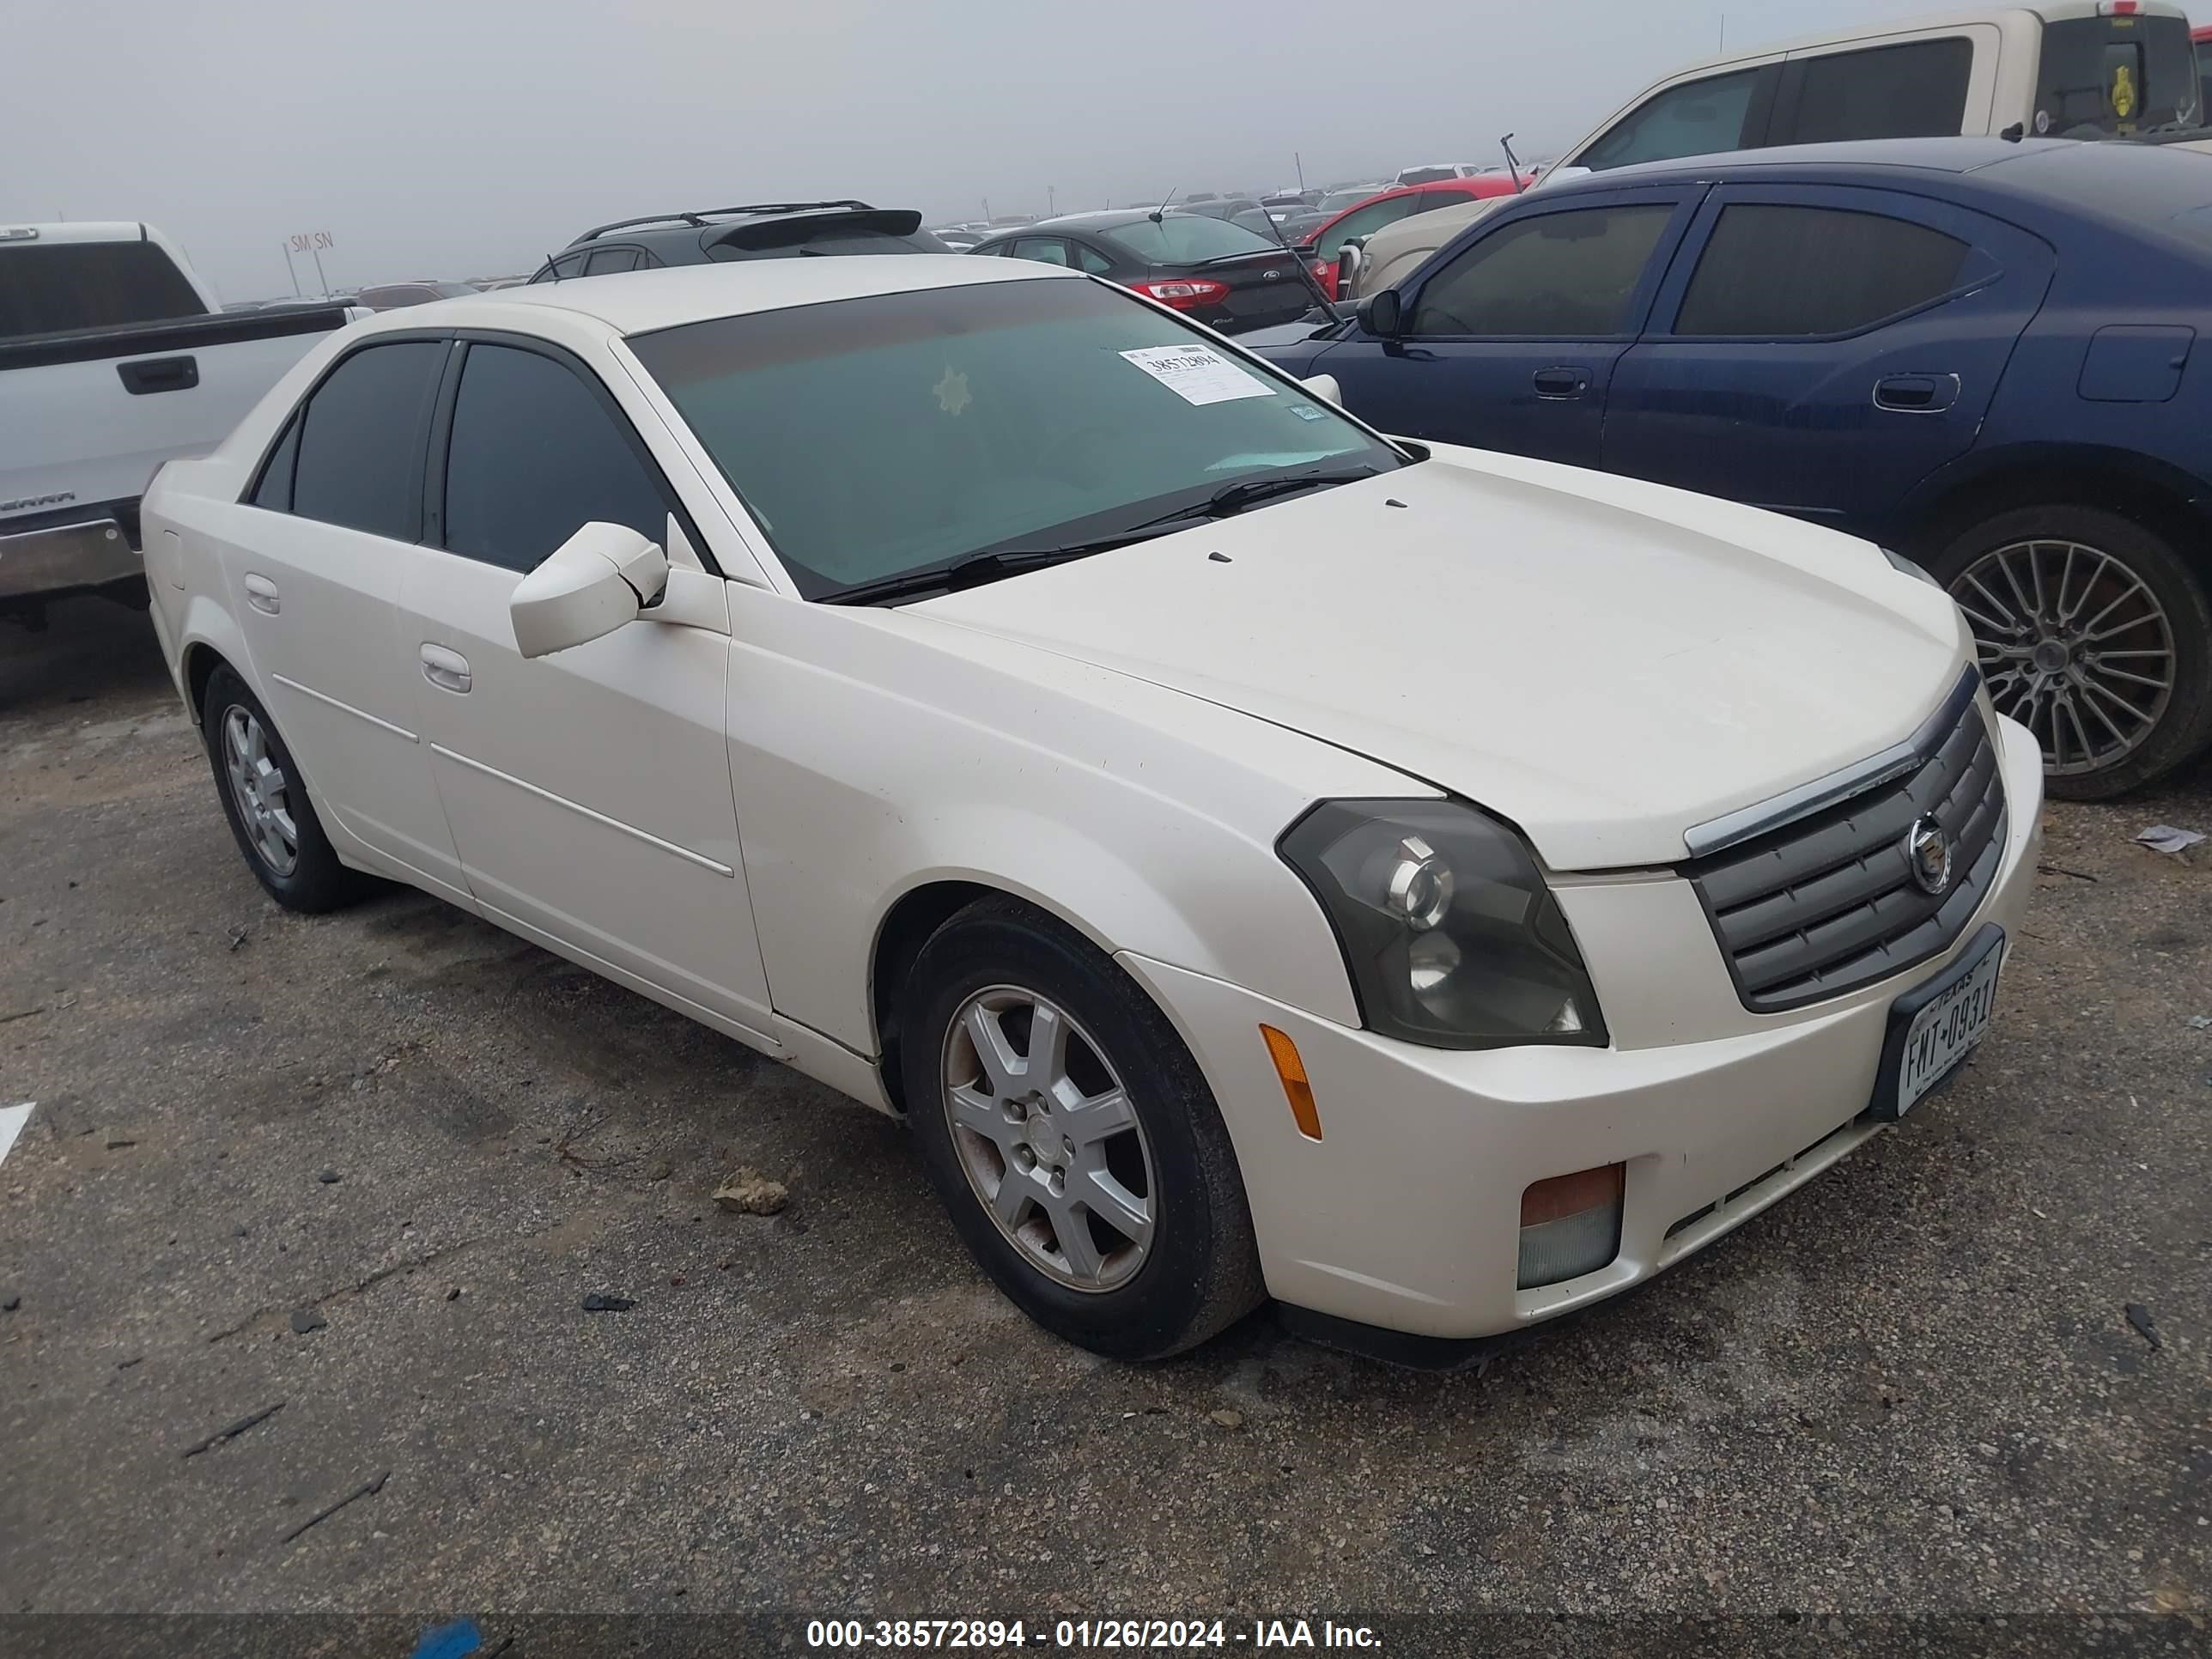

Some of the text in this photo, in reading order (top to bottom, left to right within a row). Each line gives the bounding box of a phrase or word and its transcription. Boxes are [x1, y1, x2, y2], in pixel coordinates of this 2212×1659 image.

[290, 234, 311, 252] SM
[314, 231, 334, 249] SN
[1146, 354, 1221, 372] 38572894
